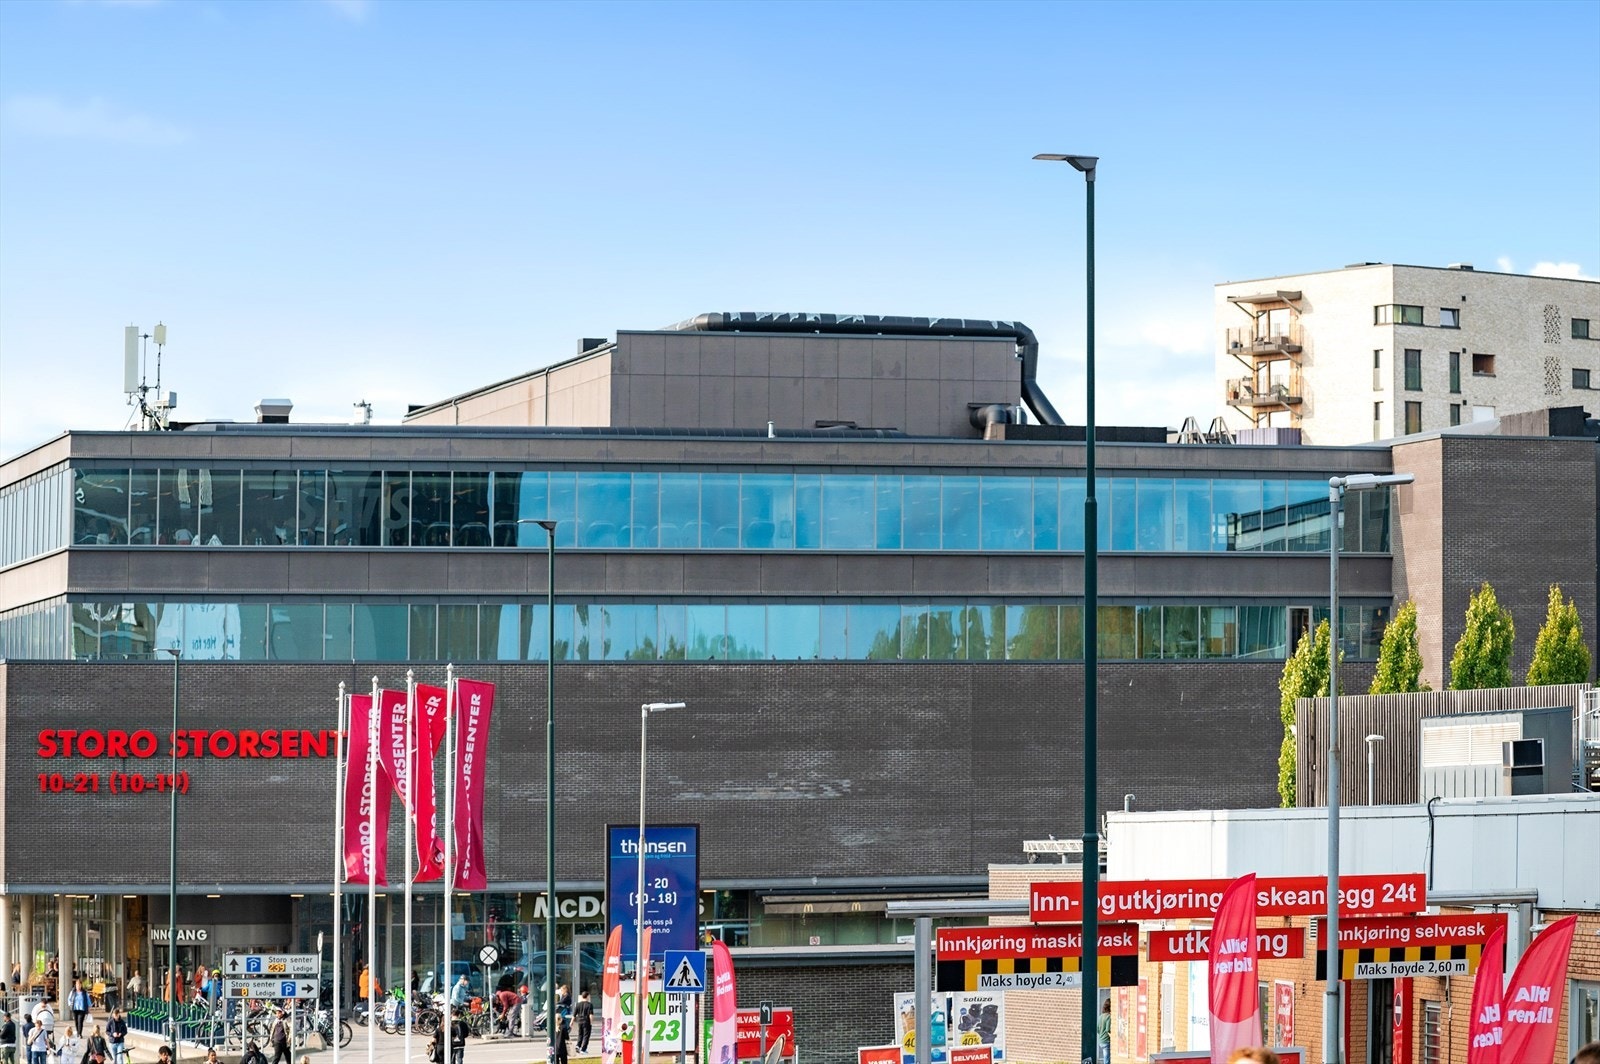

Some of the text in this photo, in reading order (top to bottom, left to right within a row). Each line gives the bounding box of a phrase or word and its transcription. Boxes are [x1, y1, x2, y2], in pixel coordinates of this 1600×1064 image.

[37, 729, 158, 759] STORO
[37, 770, 190, 795] 10-21 (10-19)
[654, 878, 668, 889] 20
[658, 892, 677, 906] 18)
[1033, 892, 1079, 912] Inn-
[1382, 882, 1417, 903] 24t
[665, 918, 673, 927] på
[151, 929, 207, 941] INNANG
[1338, 921, 1486, 944] nnkjøring selvvask
[939, 931, 1133, 954] Innkjøring maskivask
[268, 956, 288, 964] Storo
[268, 963, 286, 972] 239
[293, 964, 313, 973] Ledige
[1357, 961, 1466, 976] Maks høyde 2,60 m
[981, 974, 1012, 988] Maks
[1016, 973, 1052, 989] høyde
[255, 989, 276, 997] Ledige
[668, 992, 691, 1001] mii
[953, 1053, 989, 1062] SELVVASK
